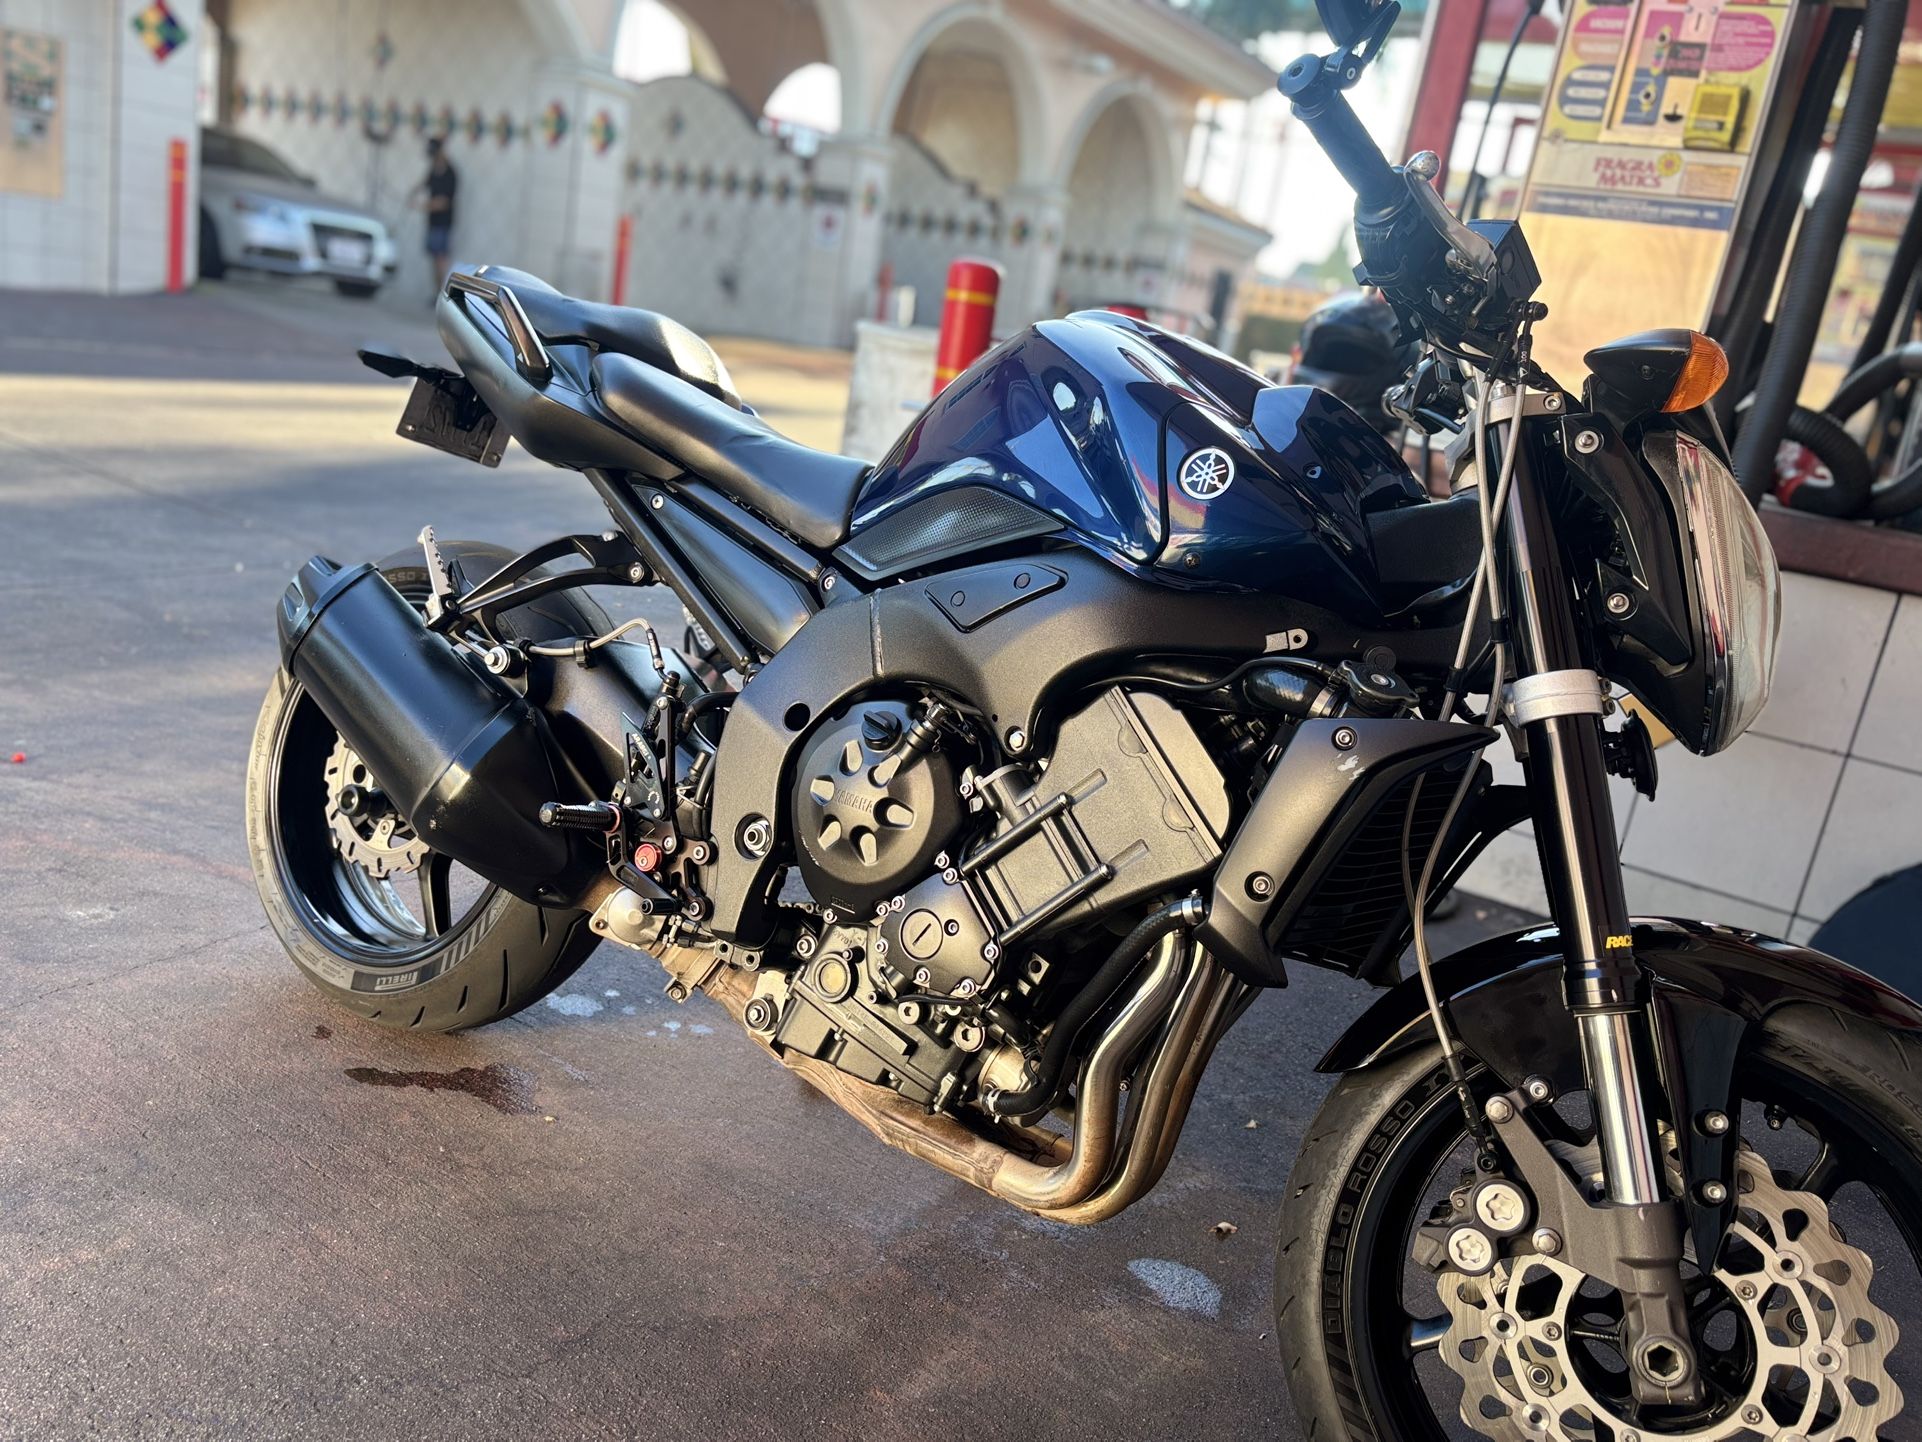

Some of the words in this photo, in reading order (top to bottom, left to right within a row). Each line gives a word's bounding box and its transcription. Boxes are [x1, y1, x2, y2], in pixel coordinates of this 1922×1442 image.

[374, 971, 418, 991] PIRELLI
[1325, 1203, 1355, 1335] DIABLO
[1346, 1100, 1416, 1195] ROSSO
